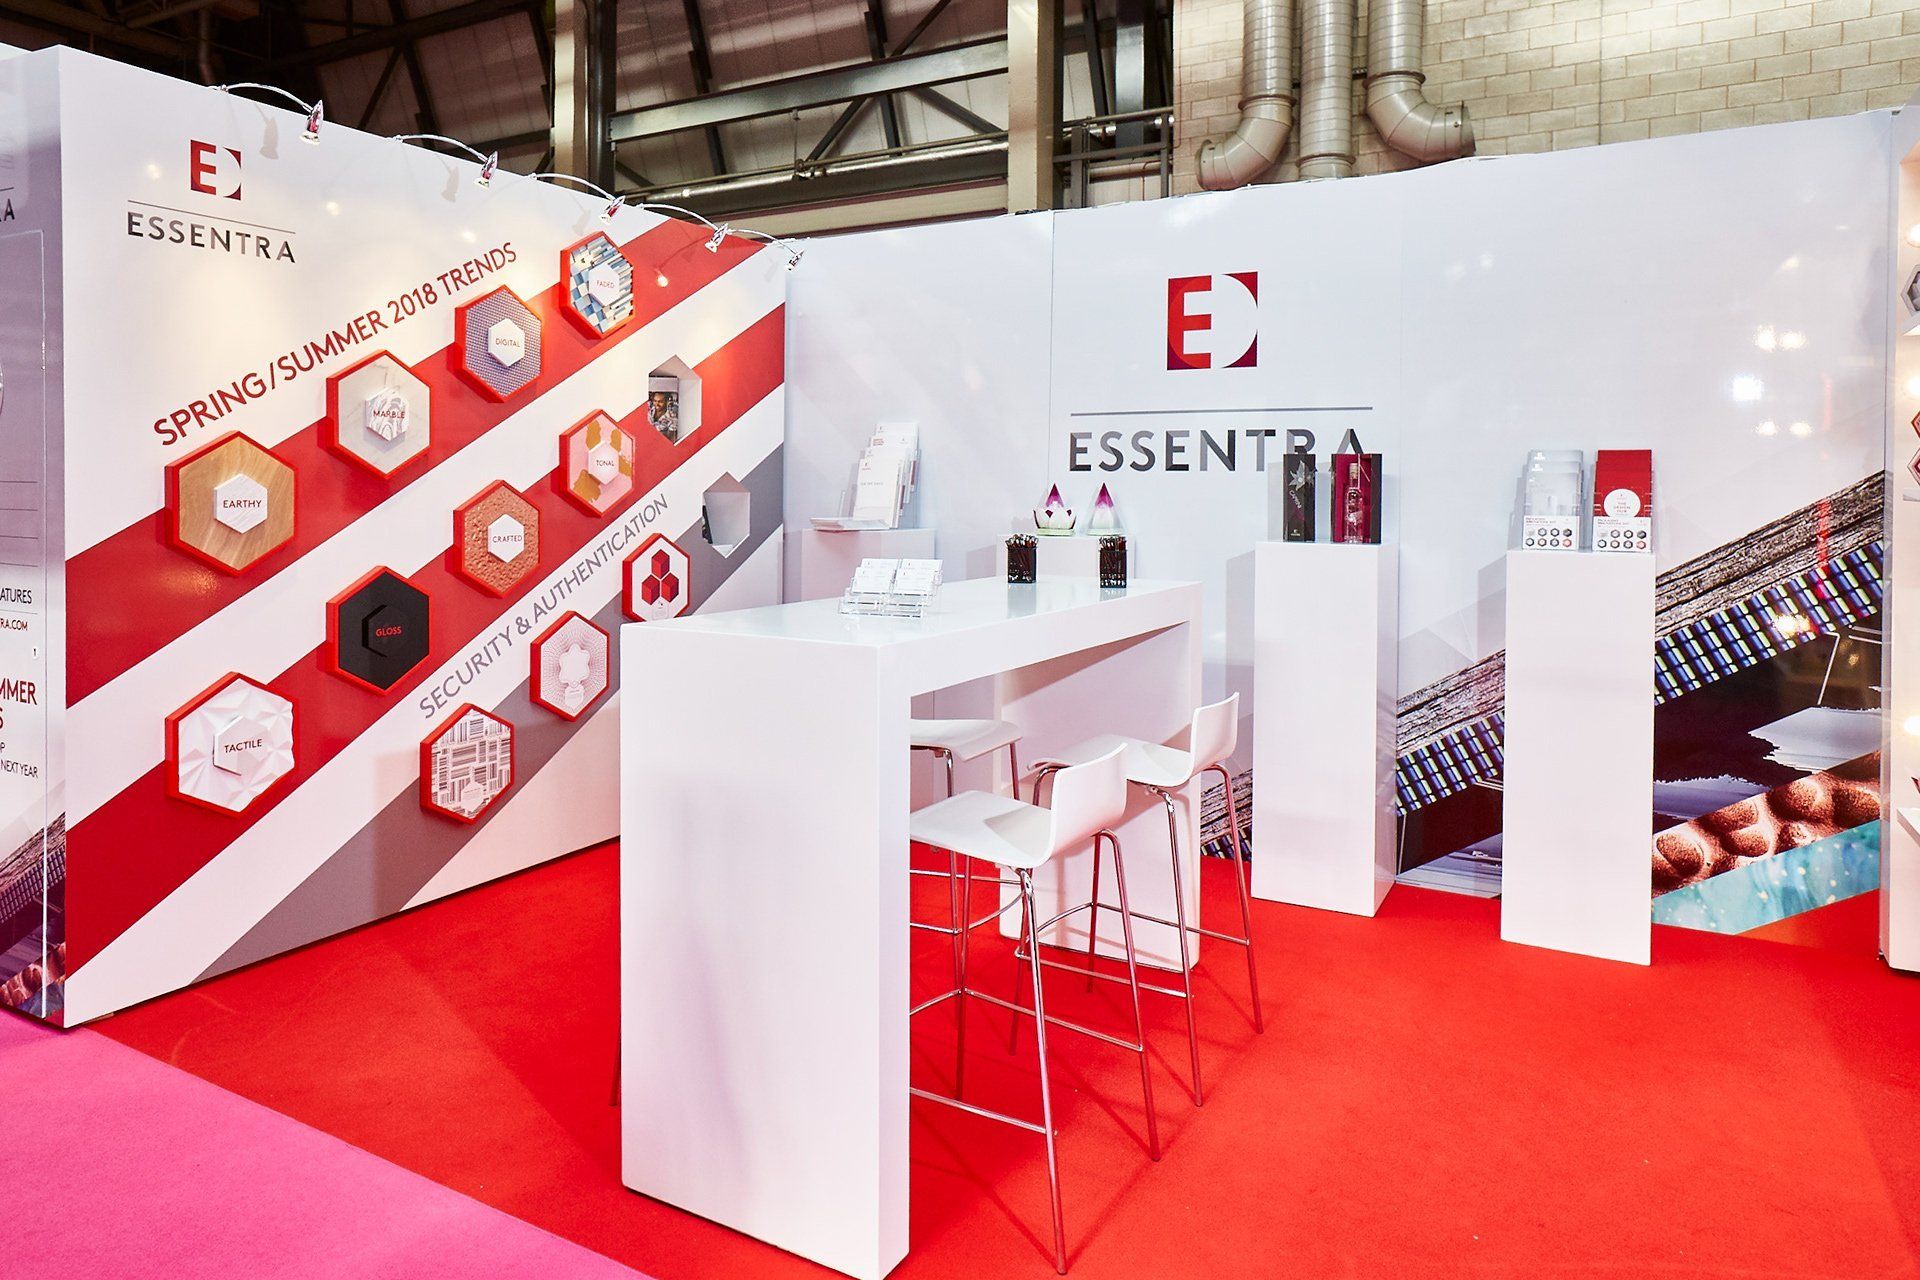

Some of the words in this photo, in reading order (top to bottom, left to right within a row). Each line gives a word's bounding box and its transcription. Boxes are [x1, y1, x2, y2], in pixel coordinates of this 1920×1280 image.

[127, 211, 296, 264] ESSENTRA
[387, 282, 439, 325] 2018
[437, 241, 518, 297] TRENDS
[495, 337, 521, 348] DIGITAL
[372, 409, 406, 419] MARBLE
[595, 459, 615, 467] TONAL
[222, 499, 262, 509] EARTHY
[491, 534, 524, 544] CRAFTED
[419, 626, 514, 719] SECURITY
[515, 615, 532, 636] &
[534, 493, 669, 624] AUTHENTICATION
[375, 626, 402, 637] GLOSS
[224, 738, 263, 754] TACTILE
[0, 759, 19, 774] NEXT
[19, 763, 39, 780] YEAR
